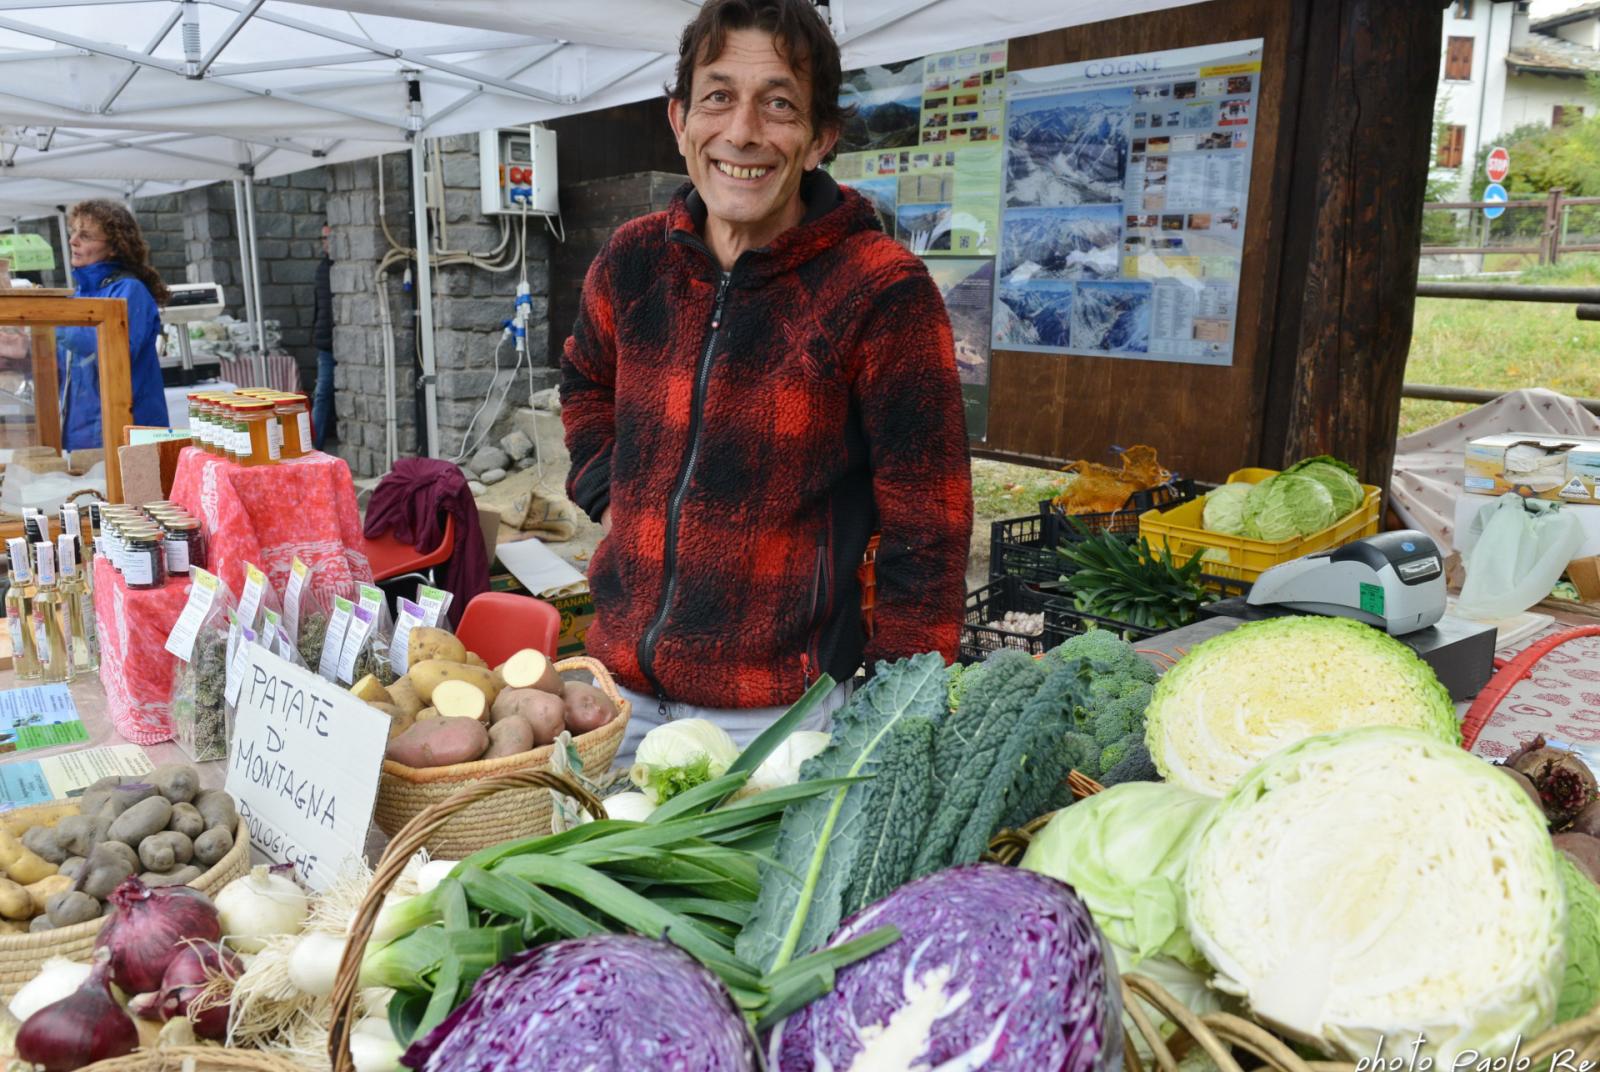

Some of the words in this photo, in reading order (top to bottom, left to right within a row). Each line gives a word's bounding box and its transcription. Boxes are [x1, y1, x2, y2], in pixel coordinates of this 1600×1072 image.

[1085, 58, 1161, 78] COGNE
[555, 594, 592, 609] BANAN
[249, 664, 334, 737] PATATE
[235, 738, 336, 829] MONTAGNA
